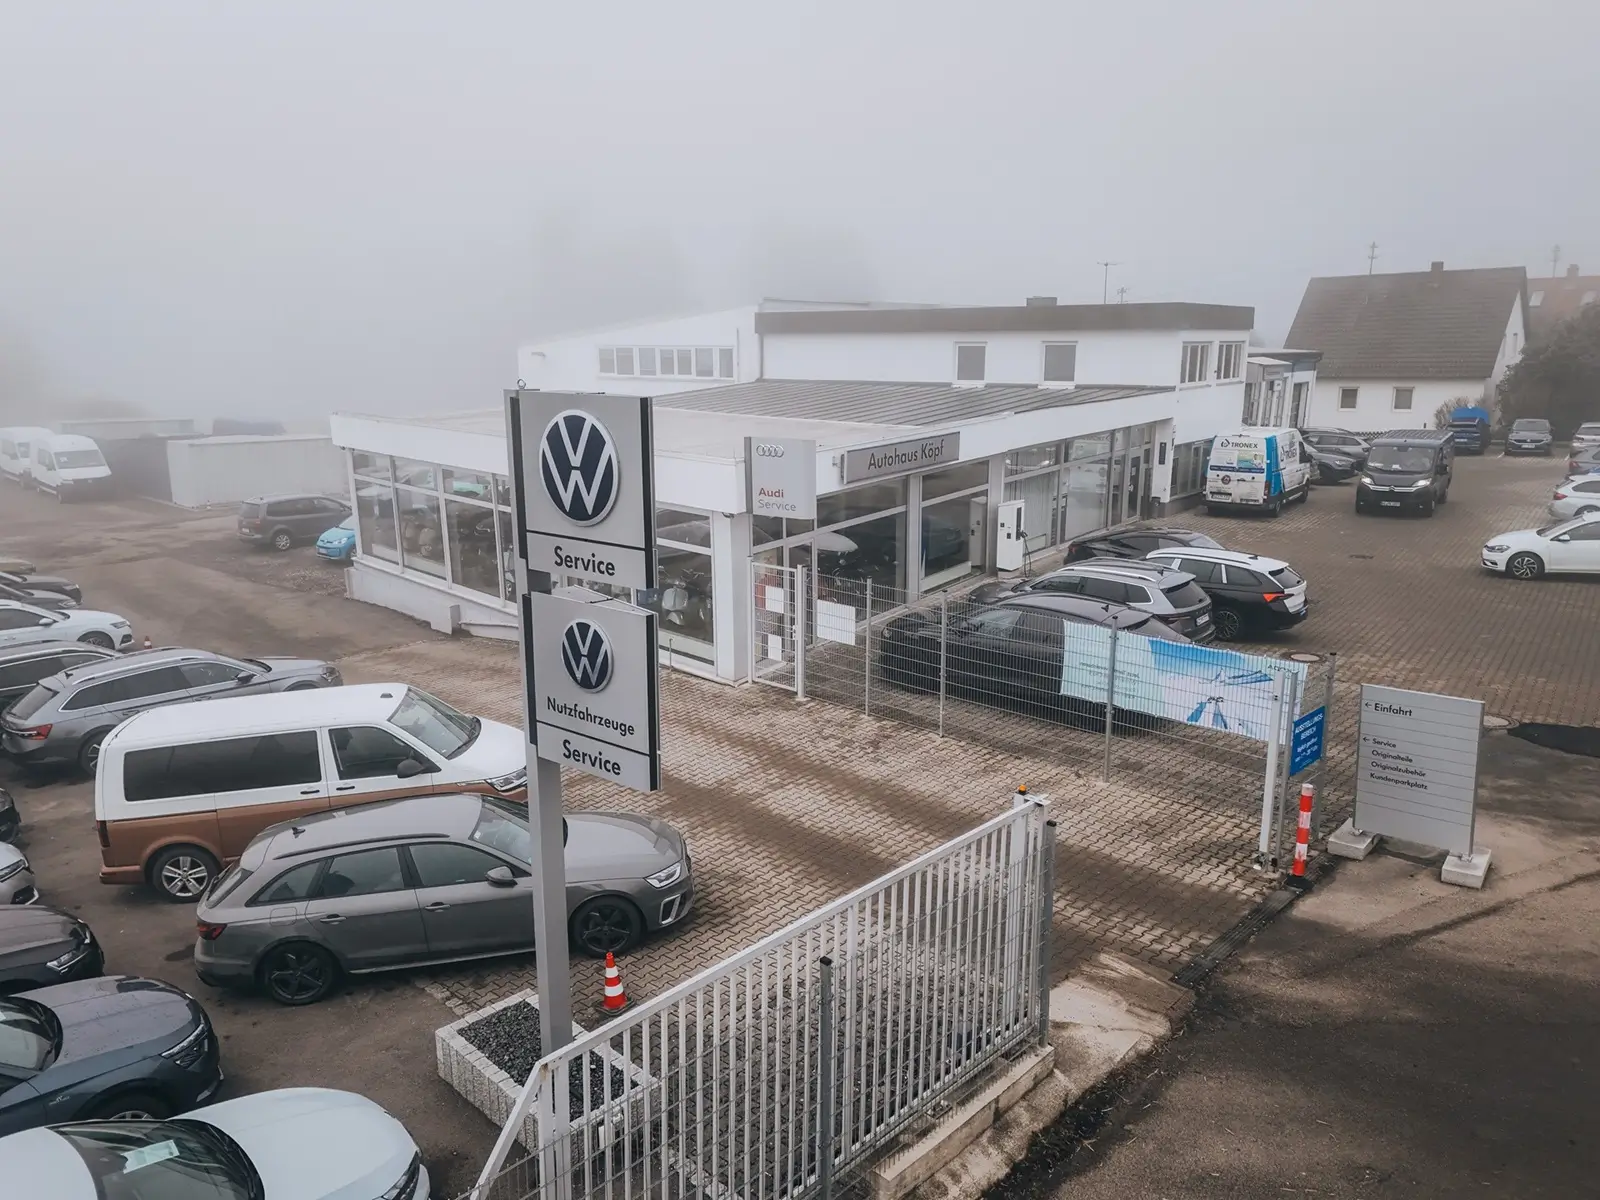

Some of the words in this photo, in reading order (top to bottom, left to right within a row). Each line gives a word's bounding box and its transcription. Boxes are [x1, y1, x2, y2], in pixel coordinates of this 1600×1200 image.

[1231, 441, 1258, 449] TRONEX
[867, 447, 918, 470] Autohaus
[920, 439, 945, 463] Köpf
[758, 487, 784, 498] Audi
[757, 499, 797, 512] Service
[554, 546, 616, 577] Service
[546, 696, 635, 737] Nutzfahrzeuge
[1374, 702, 1413, 717] Einfahrt
[1371, 738, 1397, 748] Service
[562, 739, 622, 776] Service
[1371, 749, 1413, 763] Originalteile
[1370, 760, 1427, 778] Originalzubehör
[1369, 772, 1428, 790] Kundenparkplatz
